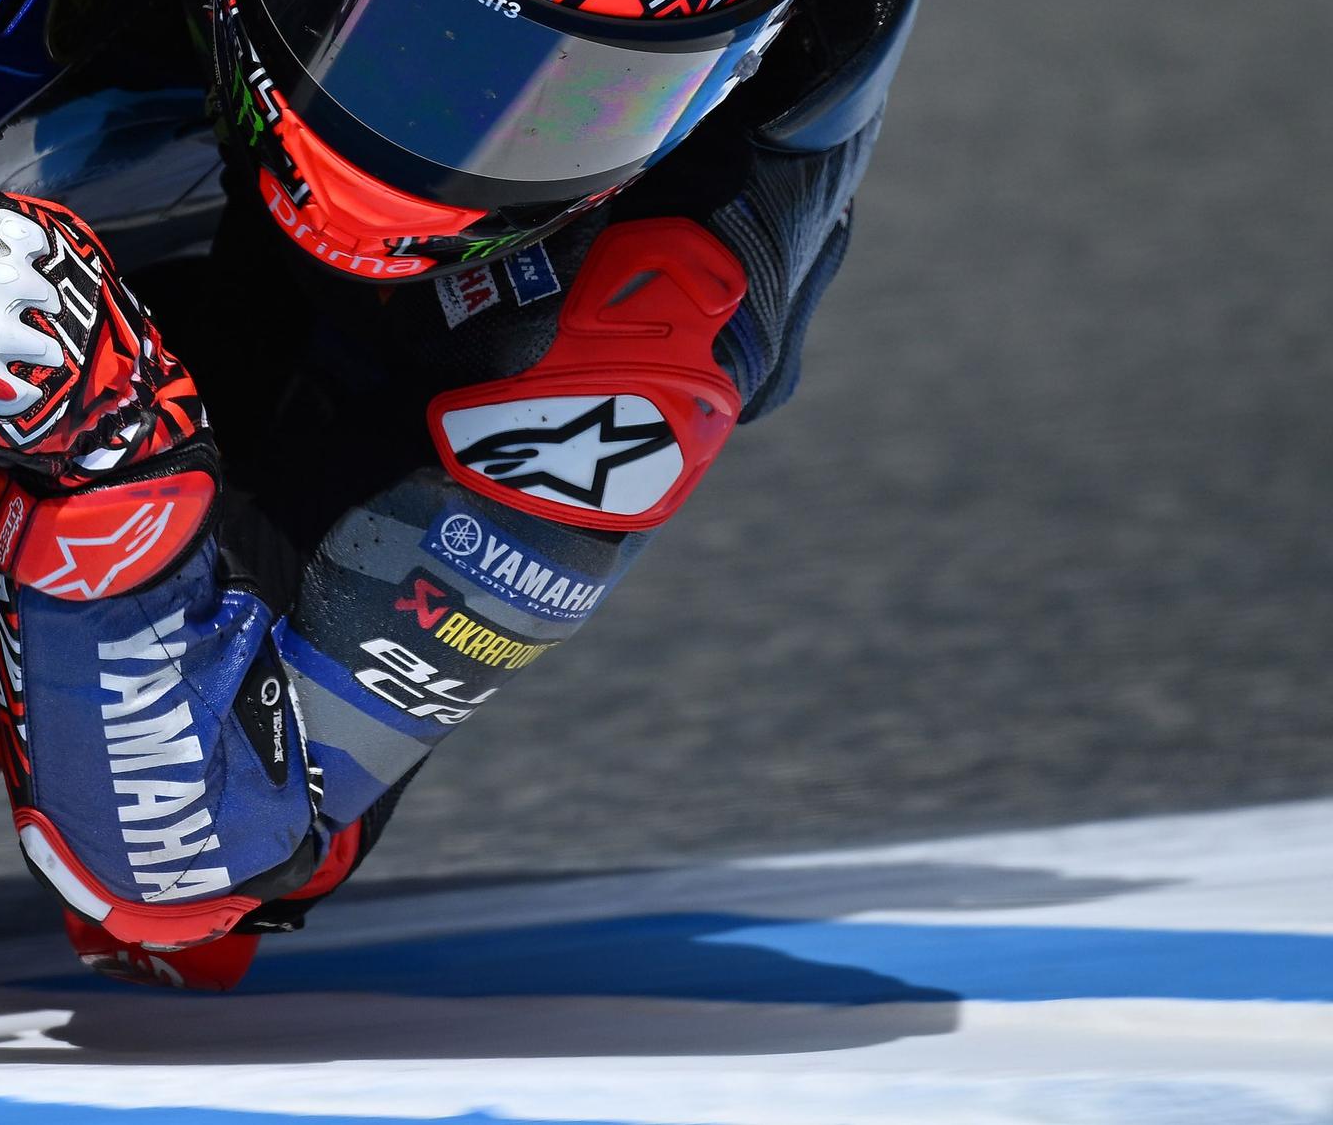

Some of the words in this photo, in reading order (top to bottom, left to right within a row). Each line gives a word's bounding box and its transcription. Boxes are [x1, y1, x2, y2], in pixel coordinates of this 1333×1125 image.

[431, 541, 519, 599] FACTORY
[479, 535, 605, 611] YAMAHA
[98, 608, 233, 903] YAMAHA
